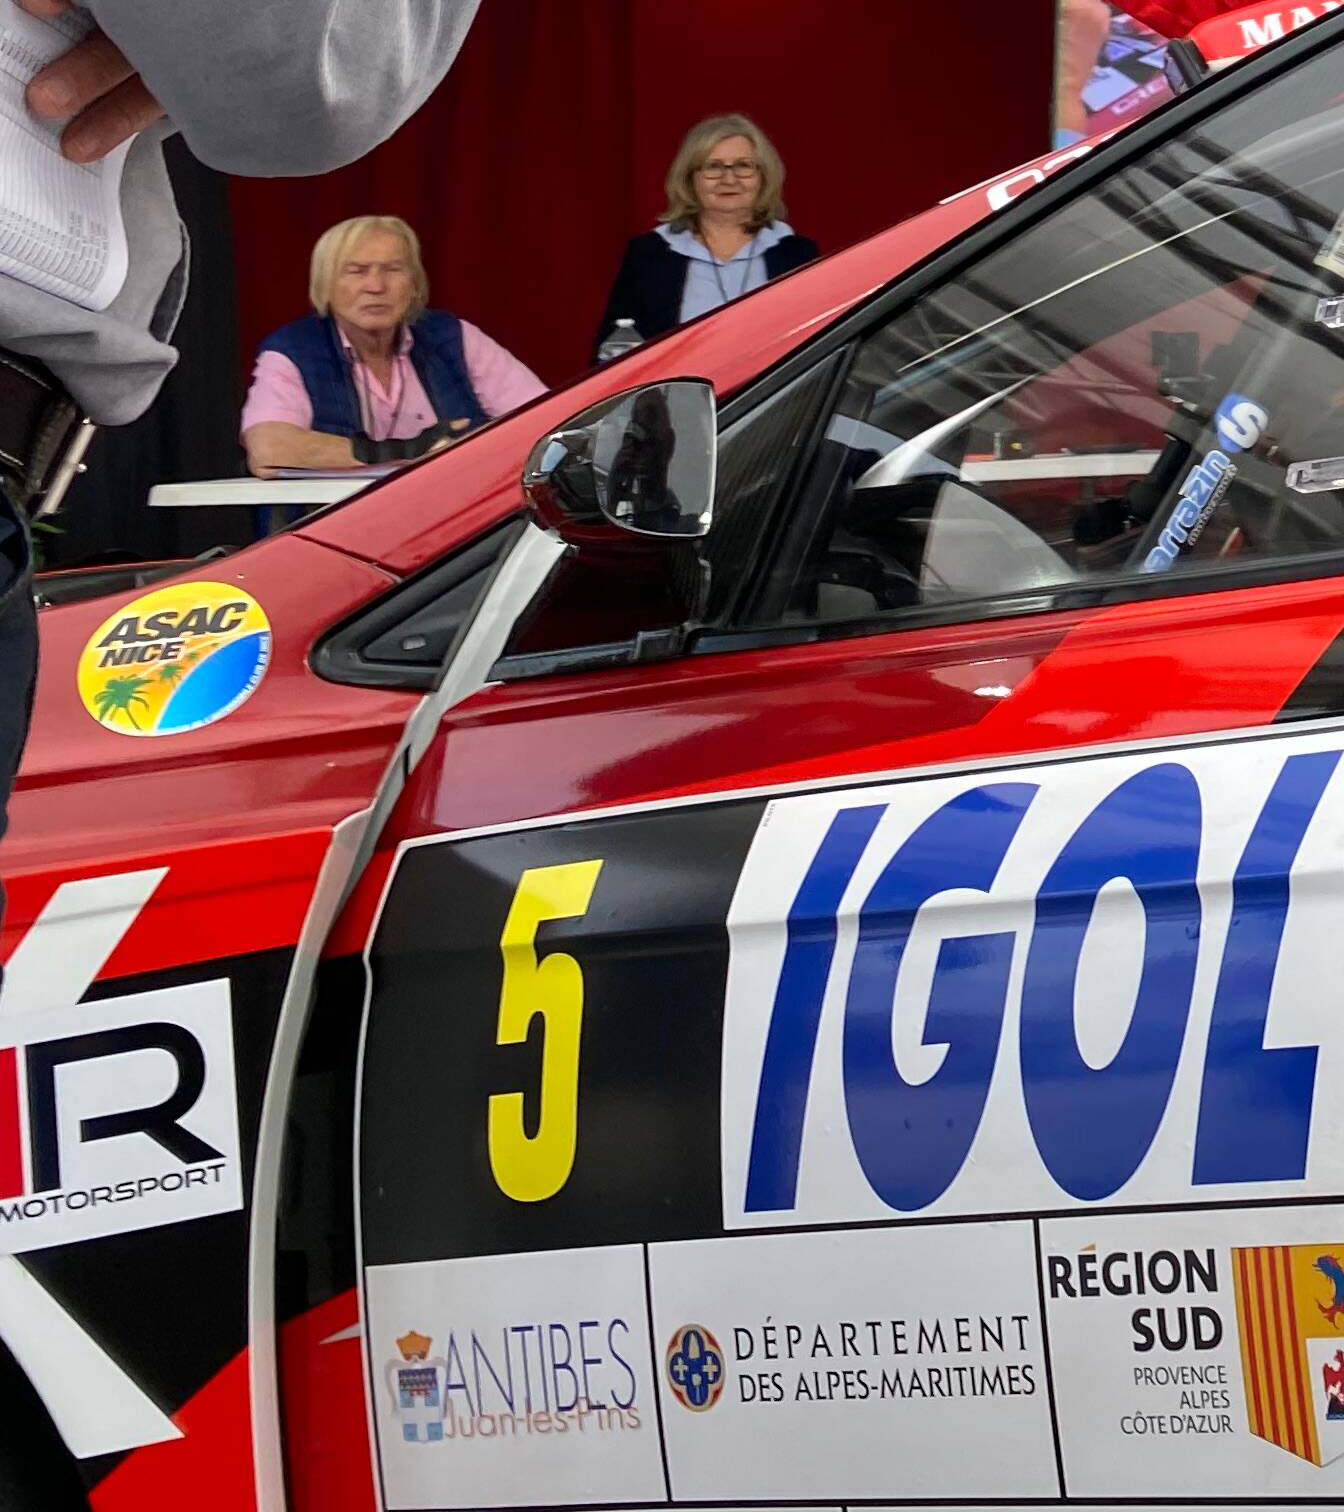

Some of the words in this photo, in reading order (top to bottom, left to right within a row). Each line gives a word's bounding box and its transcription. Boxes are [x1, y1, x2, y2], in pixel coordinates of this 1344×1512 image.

[96, 601, 249, 648] ASAC
[98, 640, 185, 668] NICE
[487, 859, 606, 1203] 5
[0, 1163, 227, 1224] MOTORSPORT
[1047, 1243, 1219, 1299] RÉGION
[733, 1315, 1031, 1361] DÉPARTEMENT
[1131, 1306, 1223, 1352] SUD
[443, 1318, 637, 1418] ANTIBES
[739, 1372, 784, 1403] DES
[795, 1364, 1036, 1401] ALPES-MARITIMES
[1133, 1365, 1228, 1386] PROVENCE
[443, 1396, 642, 1439] Juan-les-Pins
[1120, 1410, 1167, 1435] CÔTE
[1170, 1414, 1234, 1434] D'AZUR
[1180, 1389, 1231, 1410] ALPES
